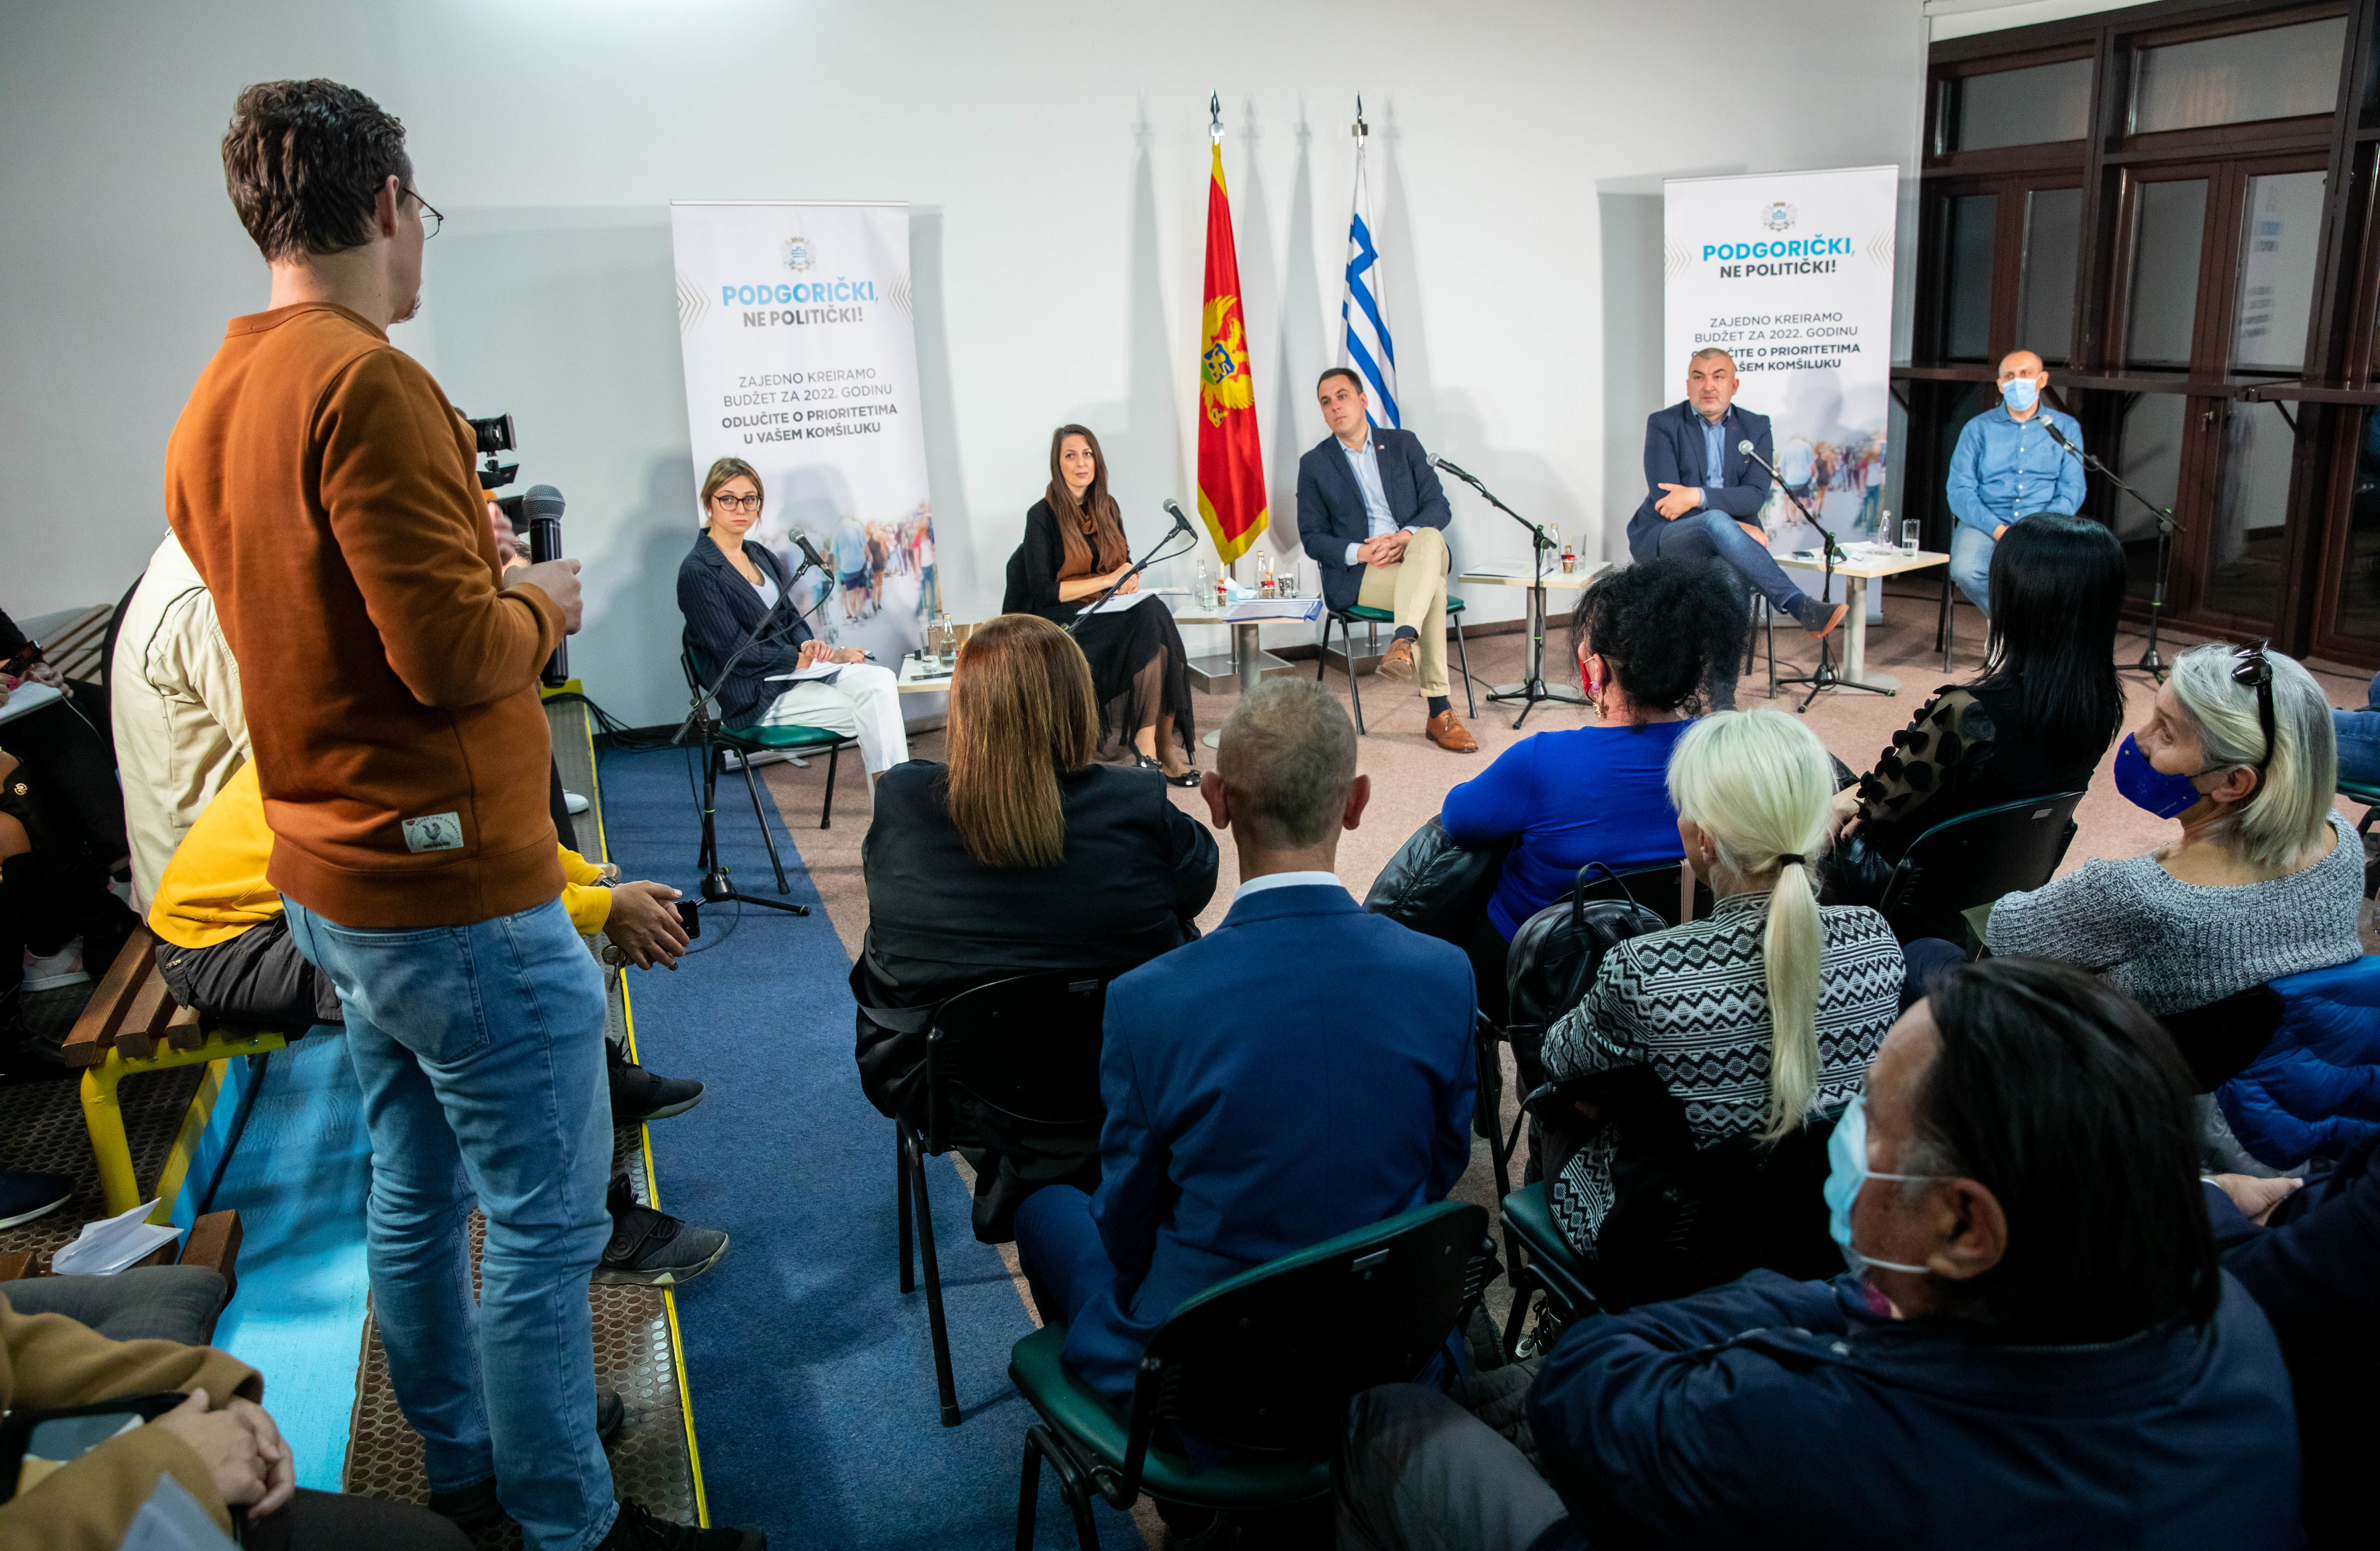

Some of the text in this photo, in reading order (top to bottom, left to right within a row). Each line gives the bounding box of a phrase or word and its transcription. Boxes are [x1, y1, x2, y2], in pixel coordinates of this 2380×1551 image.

[1703, 234, 1855, 261] PODGORIČKI,
[1720, 258, 1836, 278] NE POLITIČKI!
[722, 276, 878, 306] PODGORIČKI,
[743, 305, 863, 327] NE POLITIČKI!
[1710, 312, 1843, 328] ZAJEDNO KREIRAMO
[1695, 326, 1858, 343] BUDŽET ZA 2022. GODINU
[1758, 348, 1767, 357] O
[1771, 343, 1861, 356] PRIORITETIMA
[1735, 358, 1841, 372] ŠEM KOMŠILUKU
[739, 368, 876, 388] ZAJEDNO KREIRAMO
[723, 384, 892, 407] BUDŽET ZA 2022. GODINU
[722, 404, 898, 428] ODLUČITE O PRIORITETIMA
[744, 422, 881, 444] U VAŠEM KOMŠILUKU
